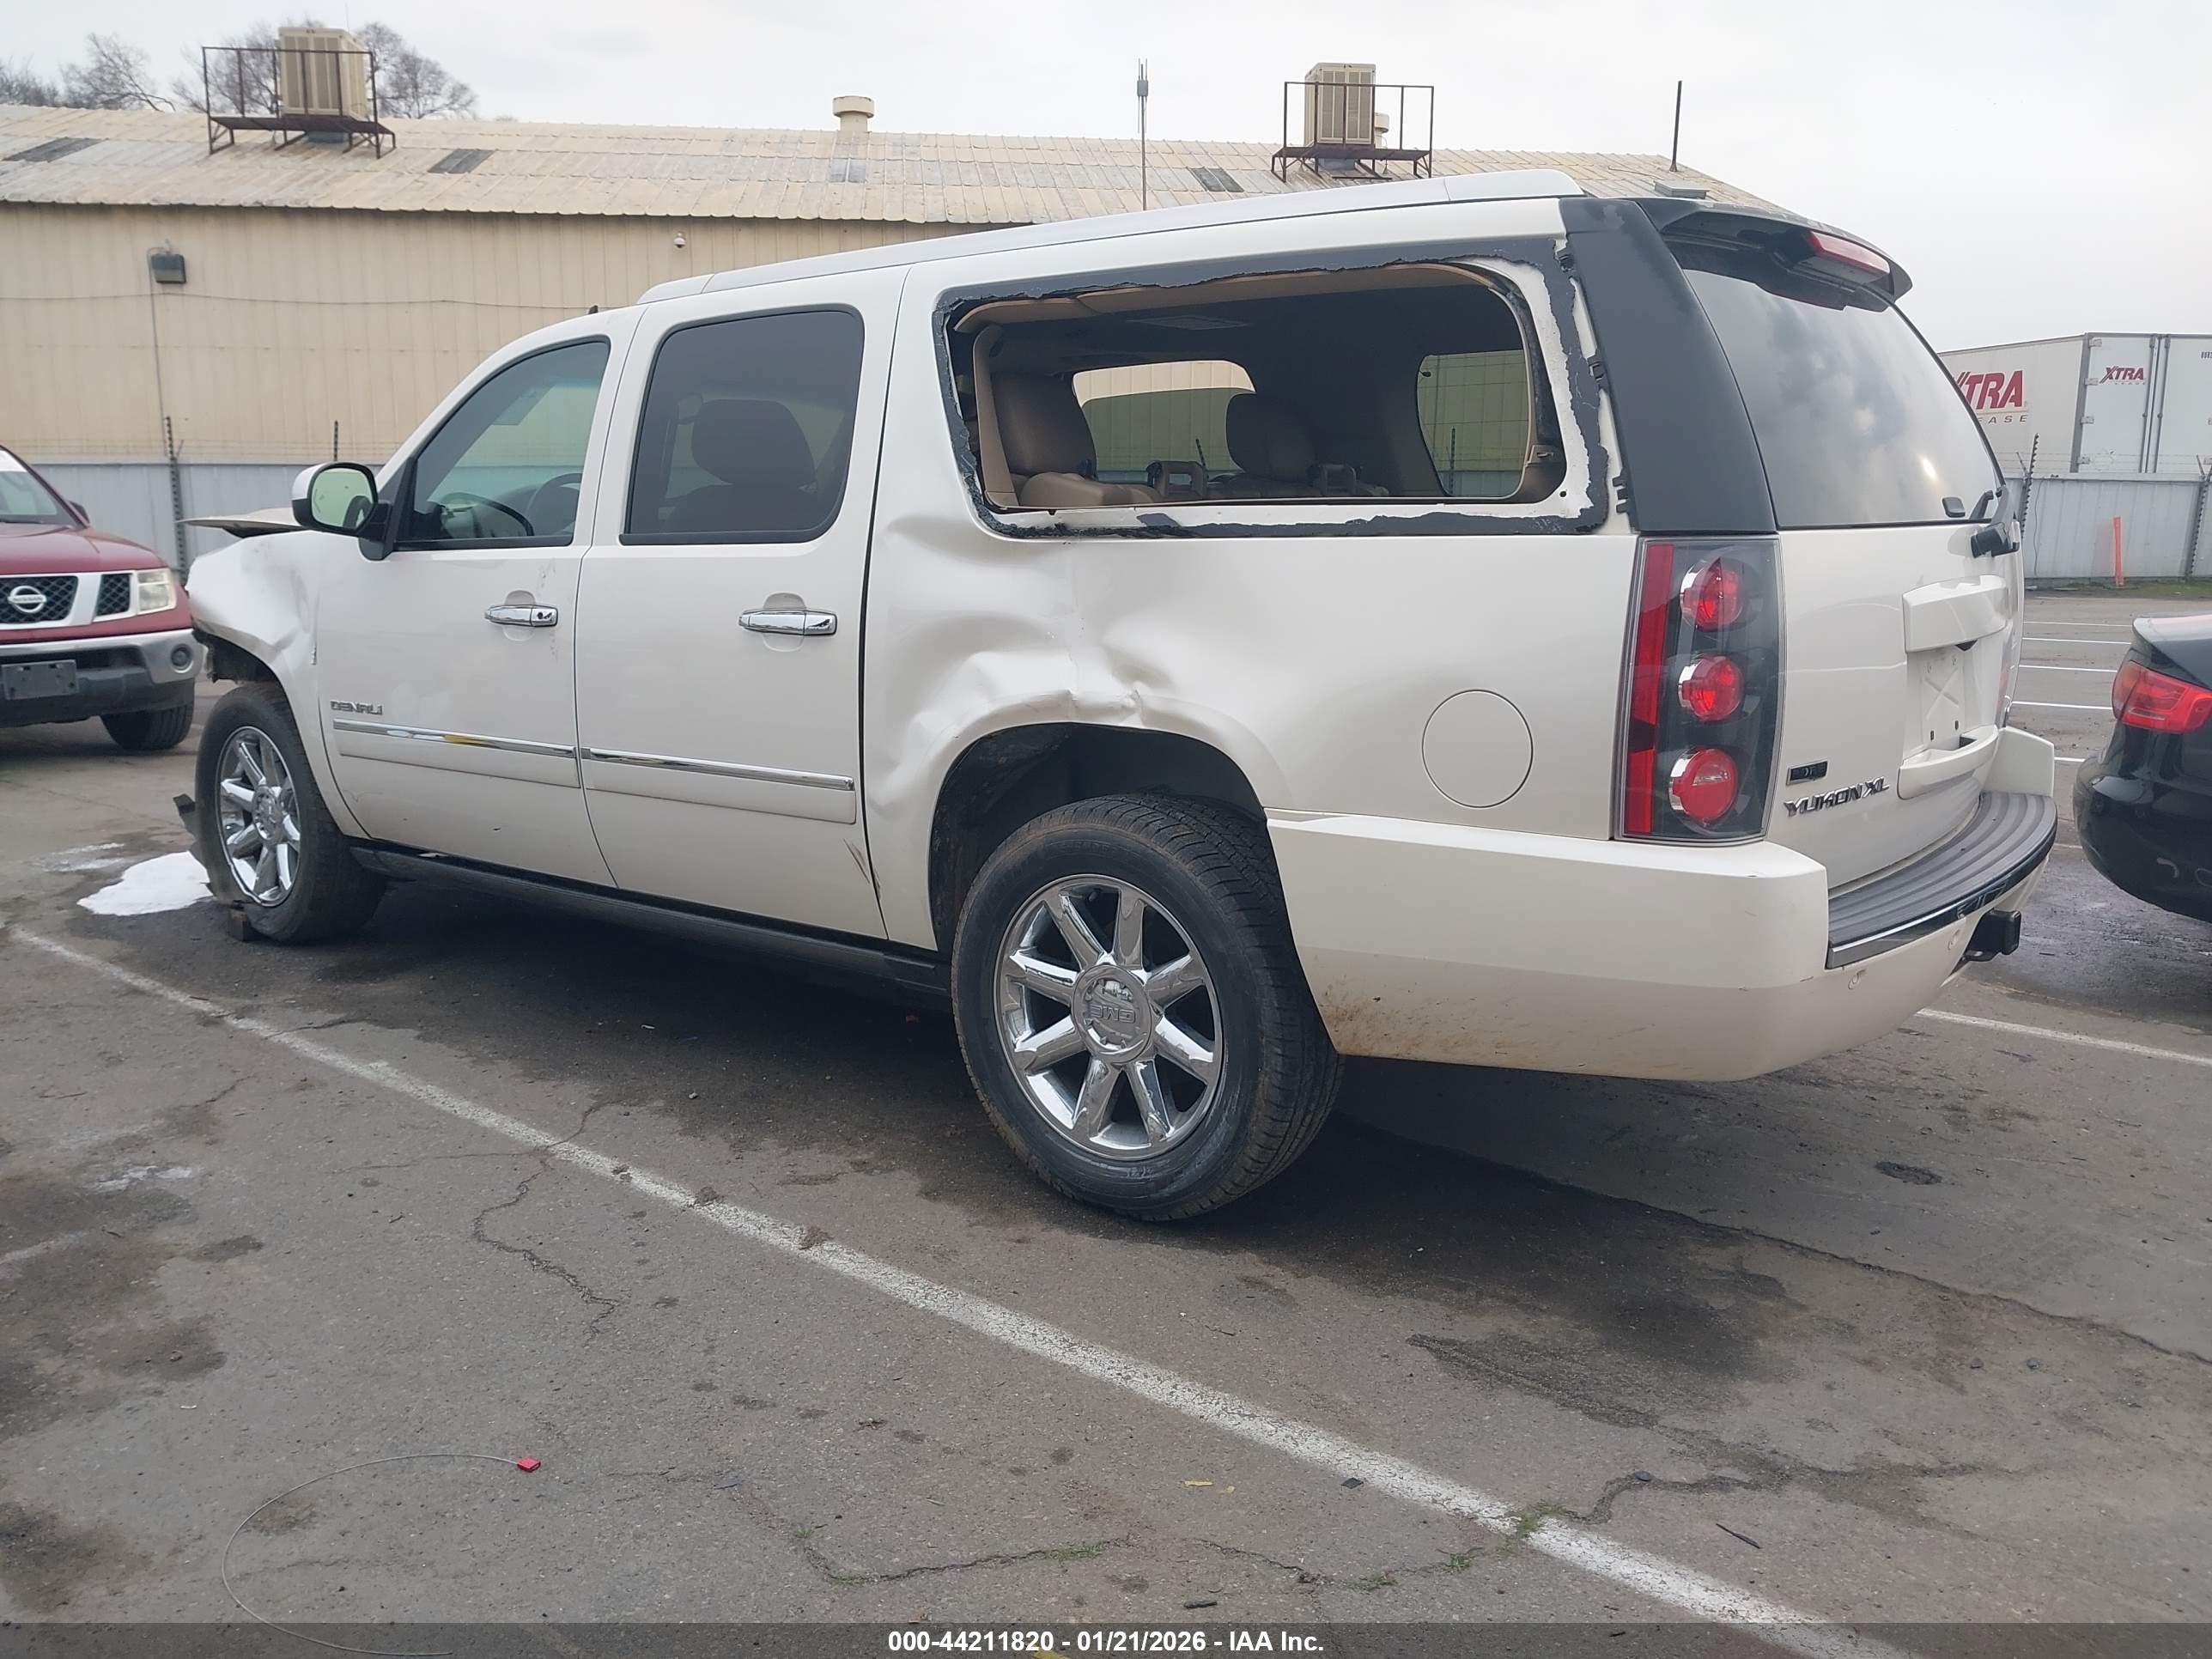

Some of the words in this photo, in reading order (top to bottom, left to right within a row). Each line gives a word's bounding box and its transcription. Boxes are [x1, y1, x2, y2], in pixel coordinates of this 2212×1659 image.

[2100, 366, 2144, 384] XTRA
[330, 700, 383, 715] DENALI
[1784, 782, 1863, 817] YUKON
[1863, 775, 1890, 798] XL
[1090, 1003, 1136, 1024] GMC
